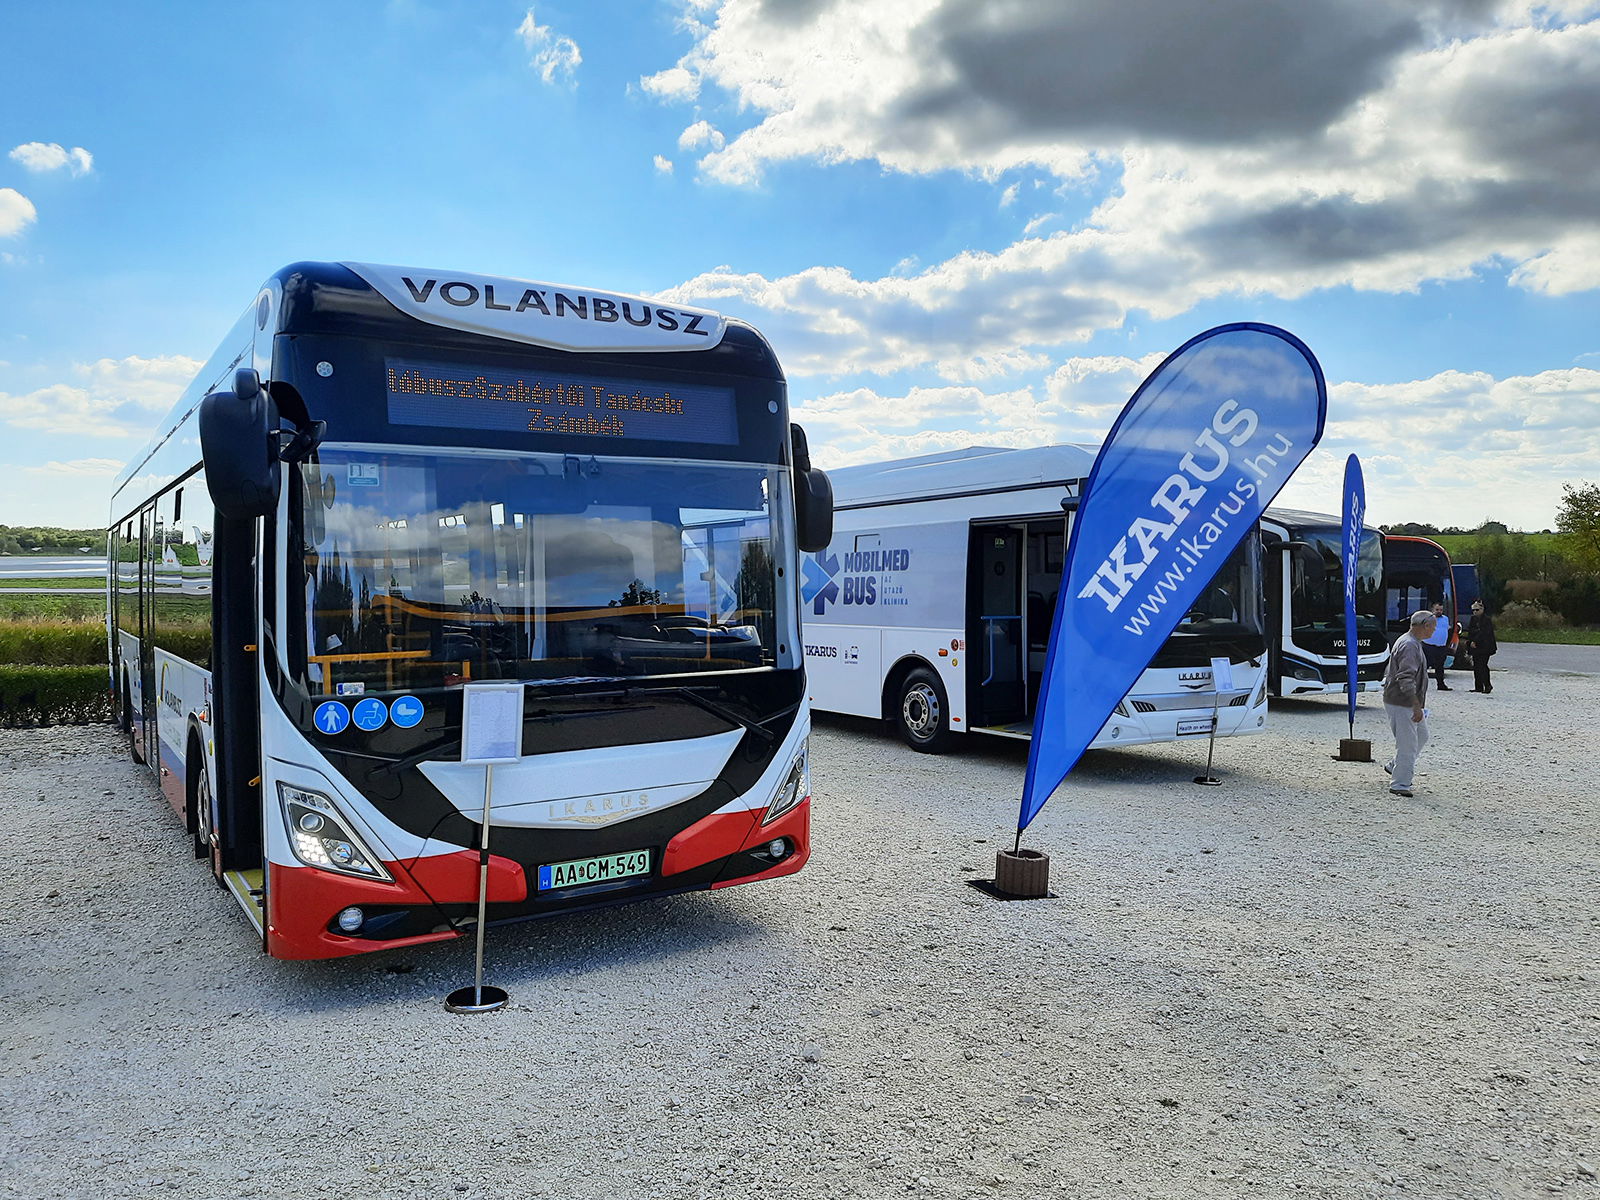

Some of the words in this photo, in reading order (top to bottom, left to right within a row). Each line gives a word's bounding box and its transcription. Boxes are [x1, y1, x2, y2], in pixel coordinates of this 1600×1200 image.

[401, 277, 709, 336] VOLÁNBUSZ
[527, 409, 624, 436] Zsámbék
[1077, 399, 1259, 613] IKARUS
[1123, 432, 1294, 636] www.ikarus.hu
[844, 549, 910, 573] MOBILMED
[843, 576, 876, 606] BUS
[804, 644, 837, 658] IKARUS
[1333, 639, 1371, 647] VOLUSZ
[1178, 671, 1212, 681] IKARUS
[550, 794, 649, 817] IKARUS
